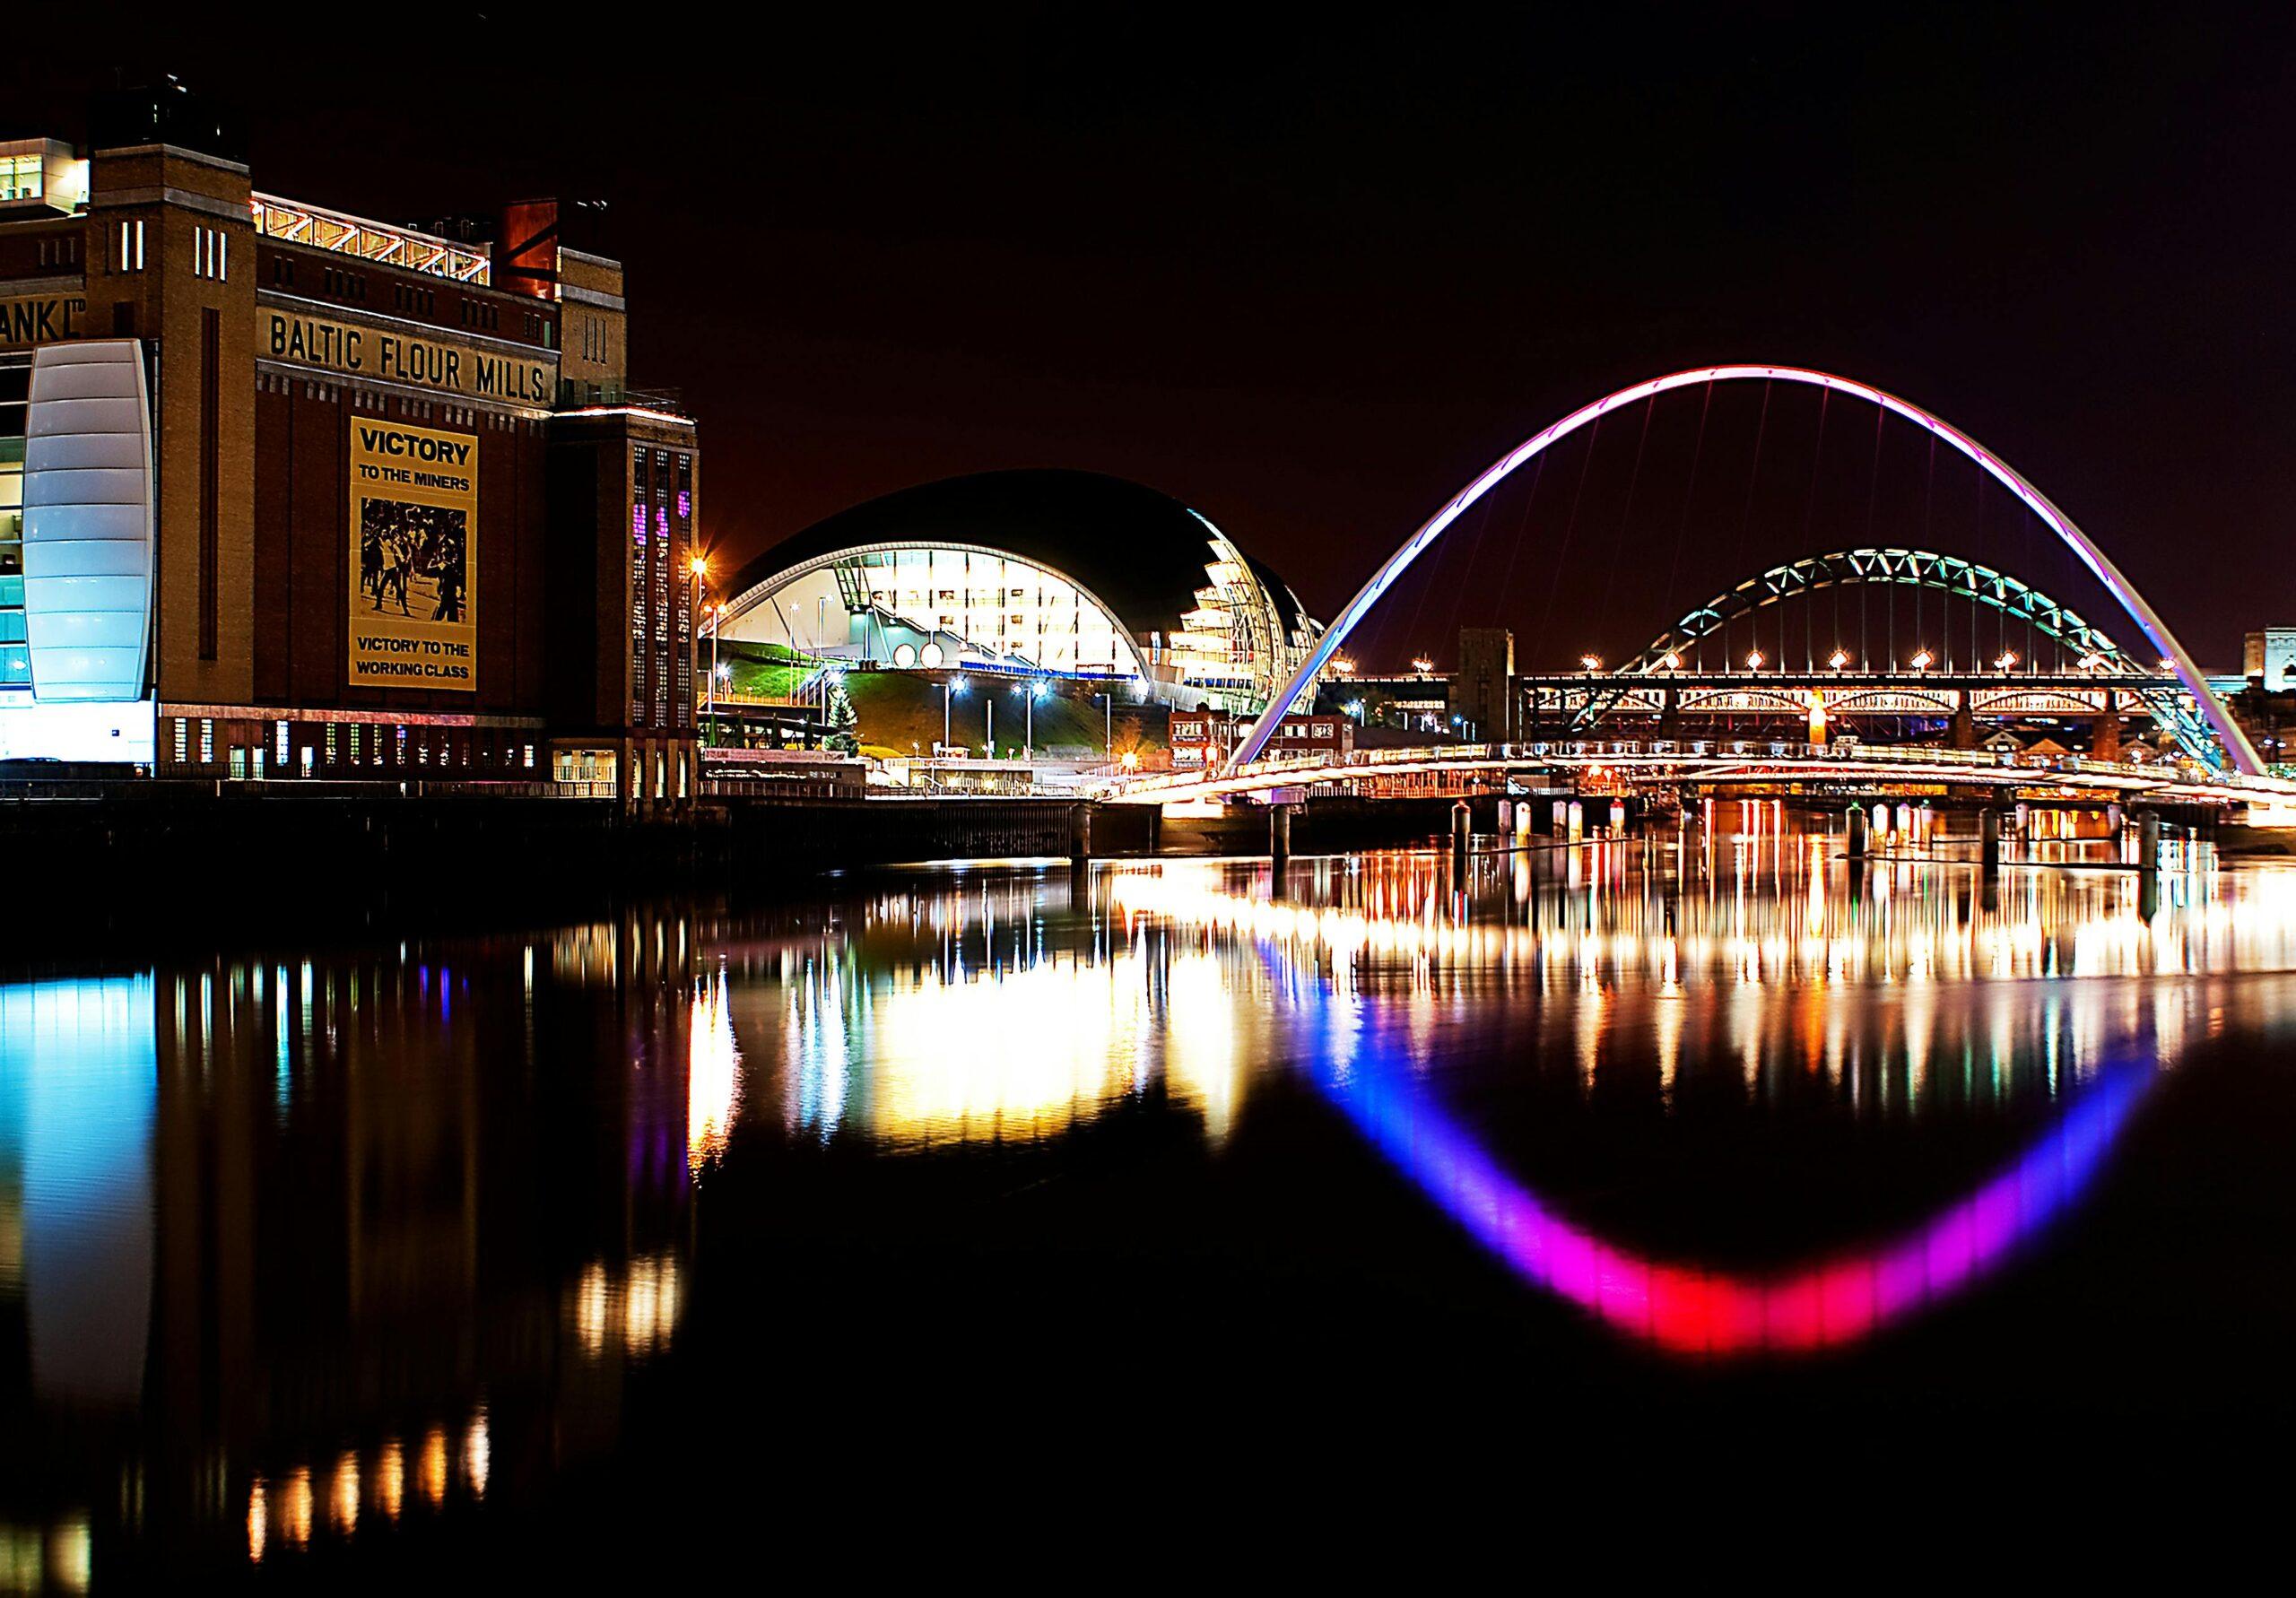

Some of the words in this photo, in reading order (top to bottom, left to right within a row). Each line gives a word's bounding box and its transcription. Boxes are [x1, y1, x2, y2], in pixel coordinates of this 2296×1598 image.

[271, 315, 362, 370] BALTIC
[380, 336, 461, 389] FLOUR
[476, 355, 544, 403] MILLS
[360, 427, 471, 465] VICTORY
[359, 464, 380, 480] TO
[381, 466, 412, 483] THE
[413, 472, 470, 491] MINERS
[357, 637, 420, 653] VICTORY
[422, 640, 441, 655] TO
[442, 642, 469, 657] THE
[356, 660, 423, 677] WORKING
[423, 664, 469, 679] CLASS
